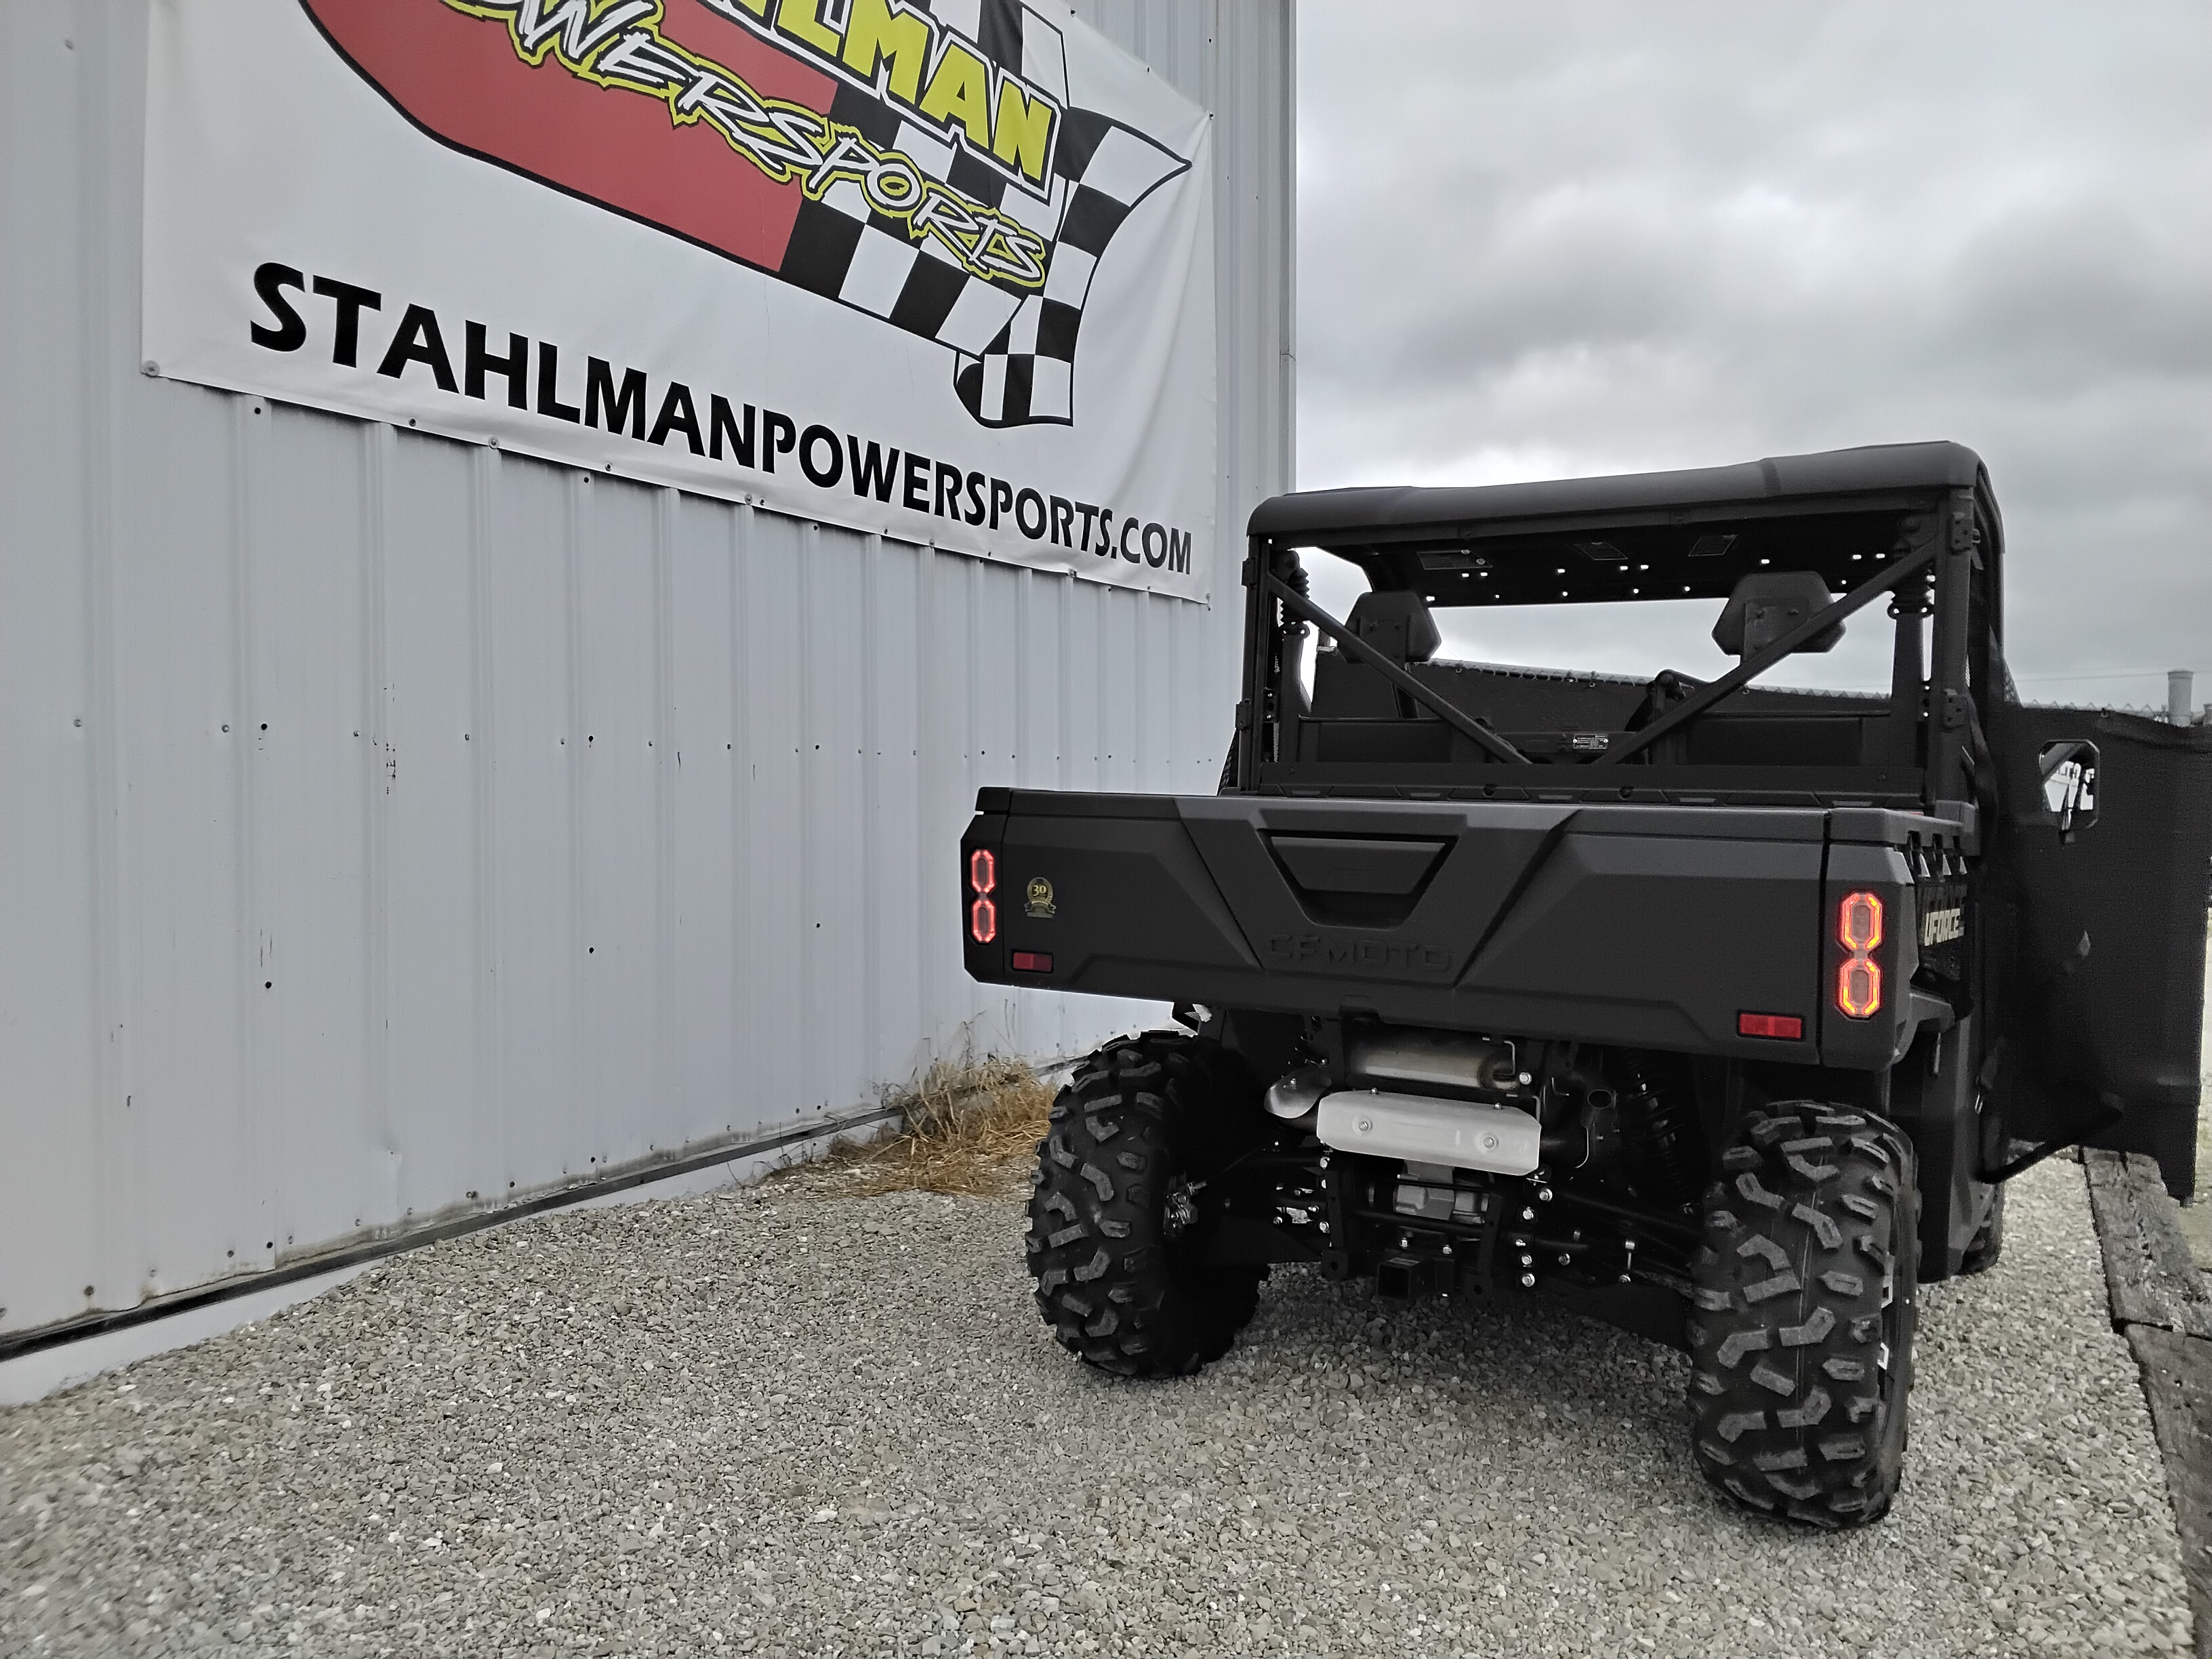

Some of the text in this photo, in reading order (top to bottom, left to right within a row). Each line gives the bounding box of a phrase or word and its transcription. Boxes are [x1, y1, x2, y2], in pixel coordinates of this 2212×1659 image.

[468, 0, 1044, 281] WERSPORTS
[739, 0, 1054, 182] LMAN
[250, 262, 1191, 575] STAHLMANPOWERSPORTS.COM
[1032, 884, 1047, 897] 30
[1270, 933, 1454, 972] CFMOTO
